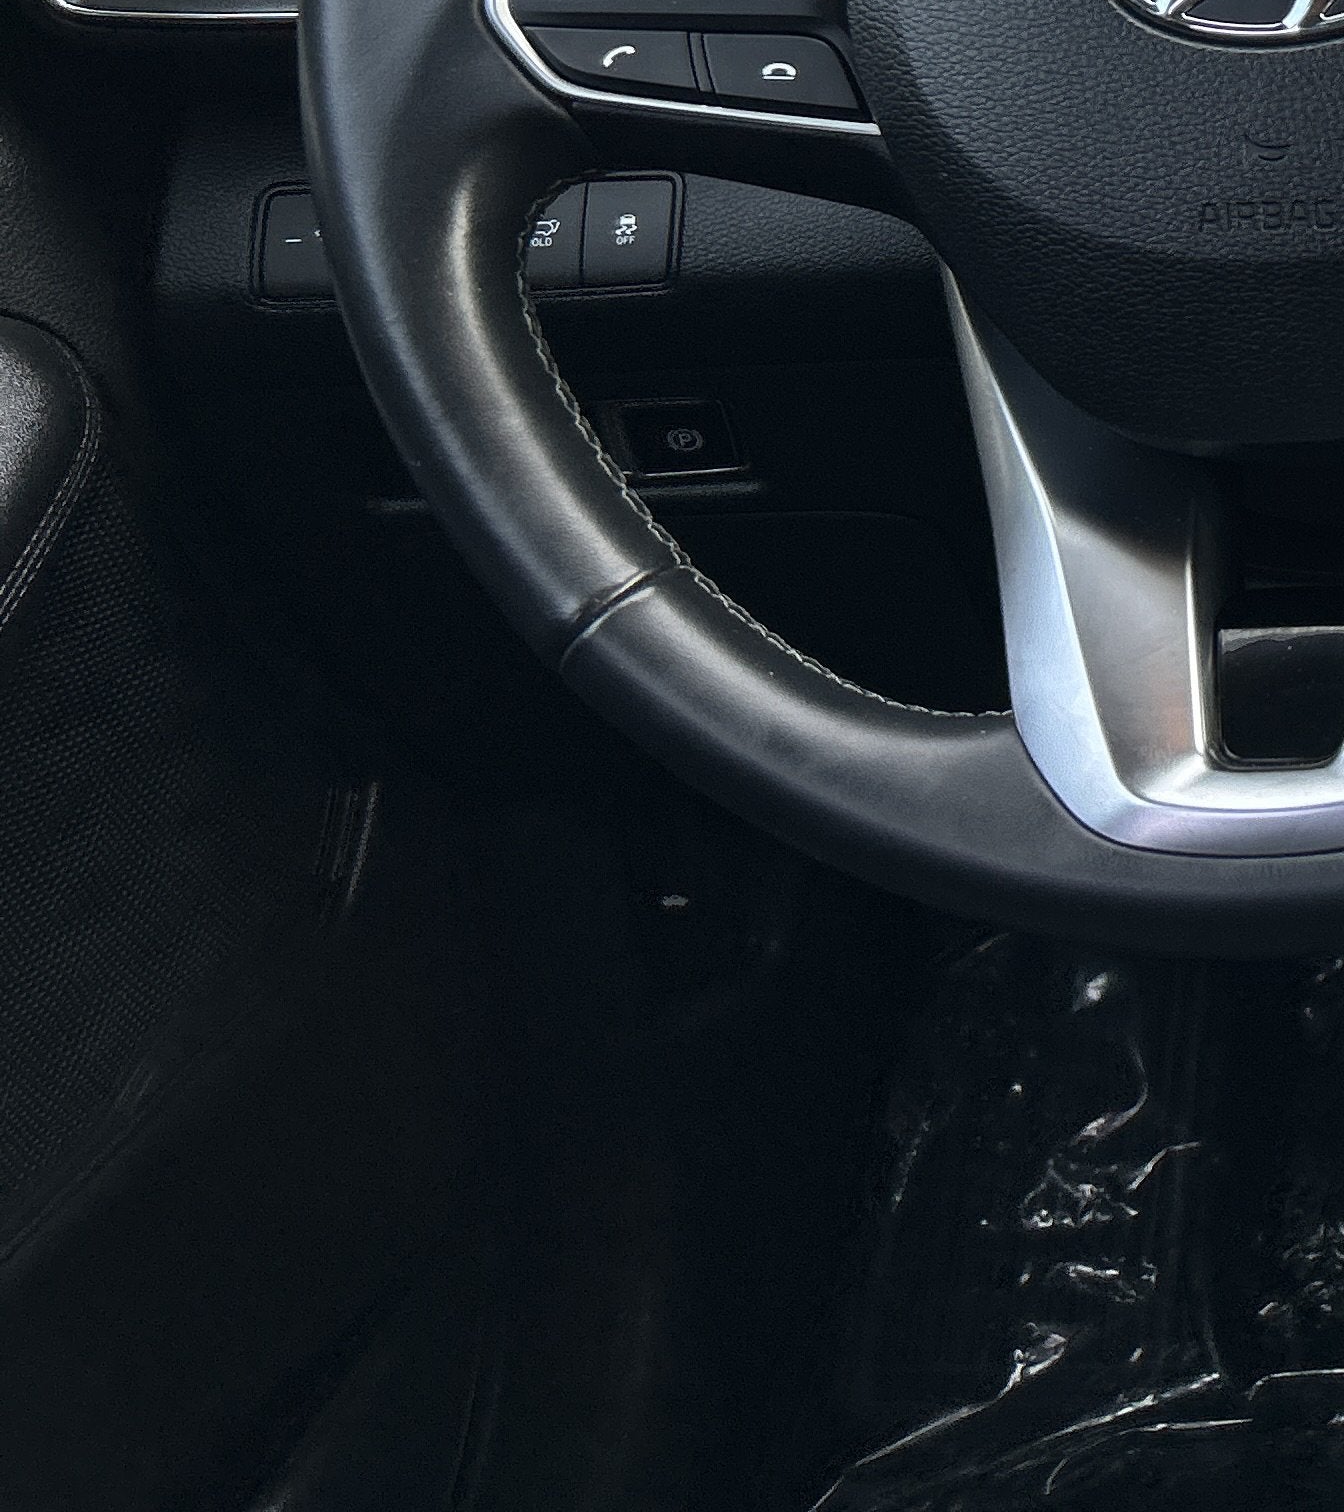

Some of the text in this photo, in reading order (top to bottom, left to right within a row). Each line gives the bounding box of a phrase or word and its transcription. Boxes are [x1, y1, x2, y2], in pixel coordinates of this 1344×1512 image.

[1202, 200, 1338, 234] AIRBAG
[530, 236, 553, 247] OLD
[616, 235, 636, 245] OFF
